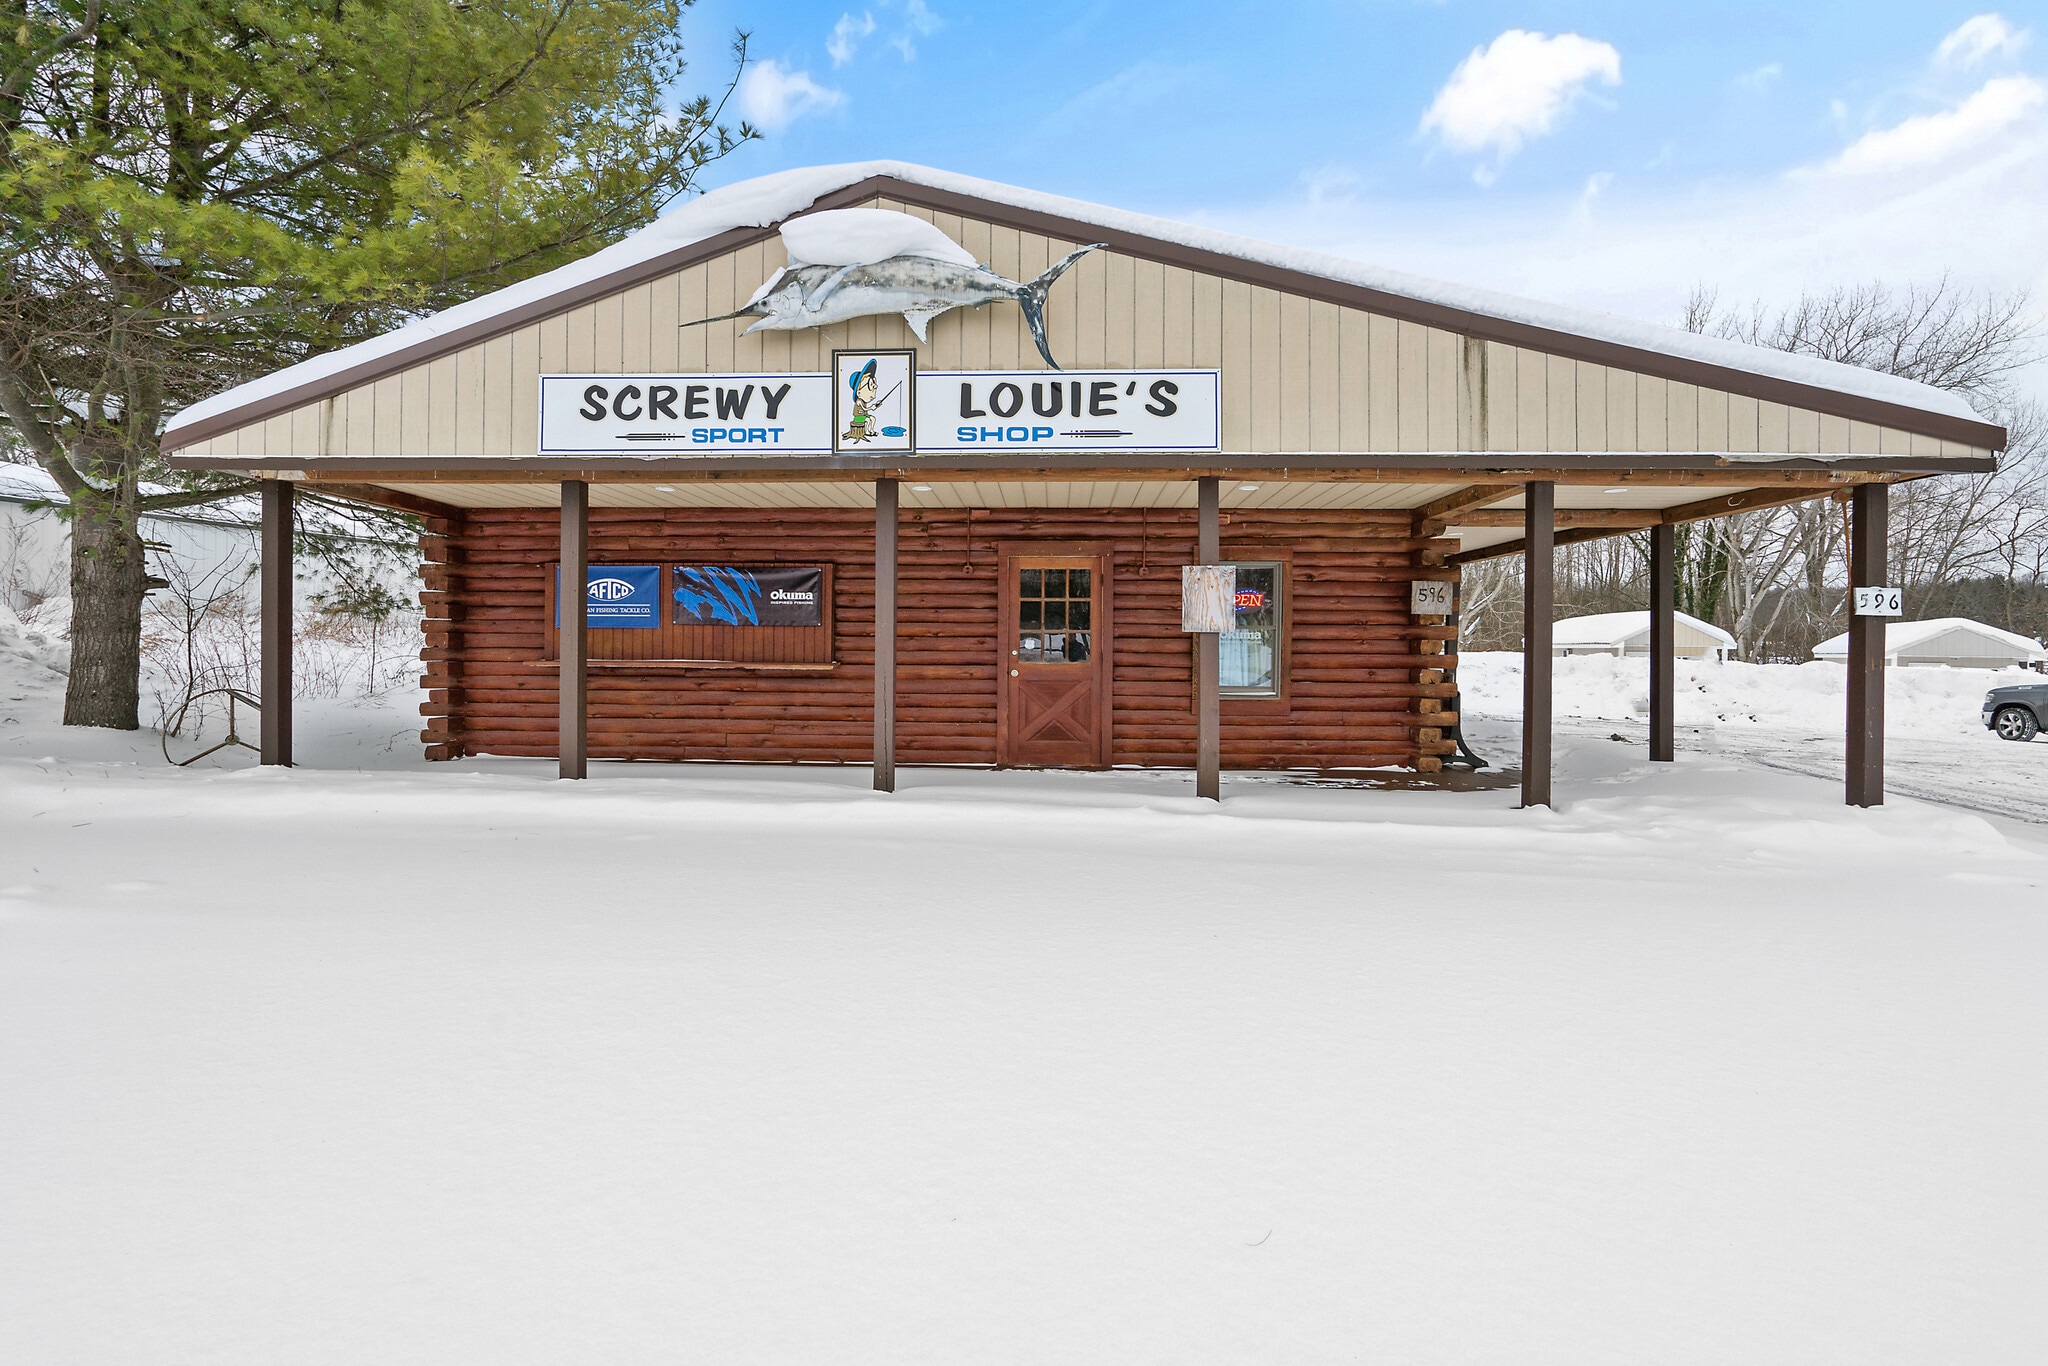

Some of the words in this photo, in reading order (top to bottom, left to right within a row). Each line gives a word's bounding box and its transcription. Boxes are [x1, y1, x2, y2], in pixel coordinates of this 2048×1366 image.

[579, 383, 792, 421] SCREWY
[959, 379, 1180, 418] LOUIE'S
[691, 427, 785, 443] SPORT
[956, 426, 1054, 442] SHOP
[588, 579, 629, 600] AFTCO
[770, 588, 814, 600] okuma
[1418, 586, 1445, 604] 596
[1234, 594, 1263, 607] PEN
[1860, 593, 1899, 610] 596
